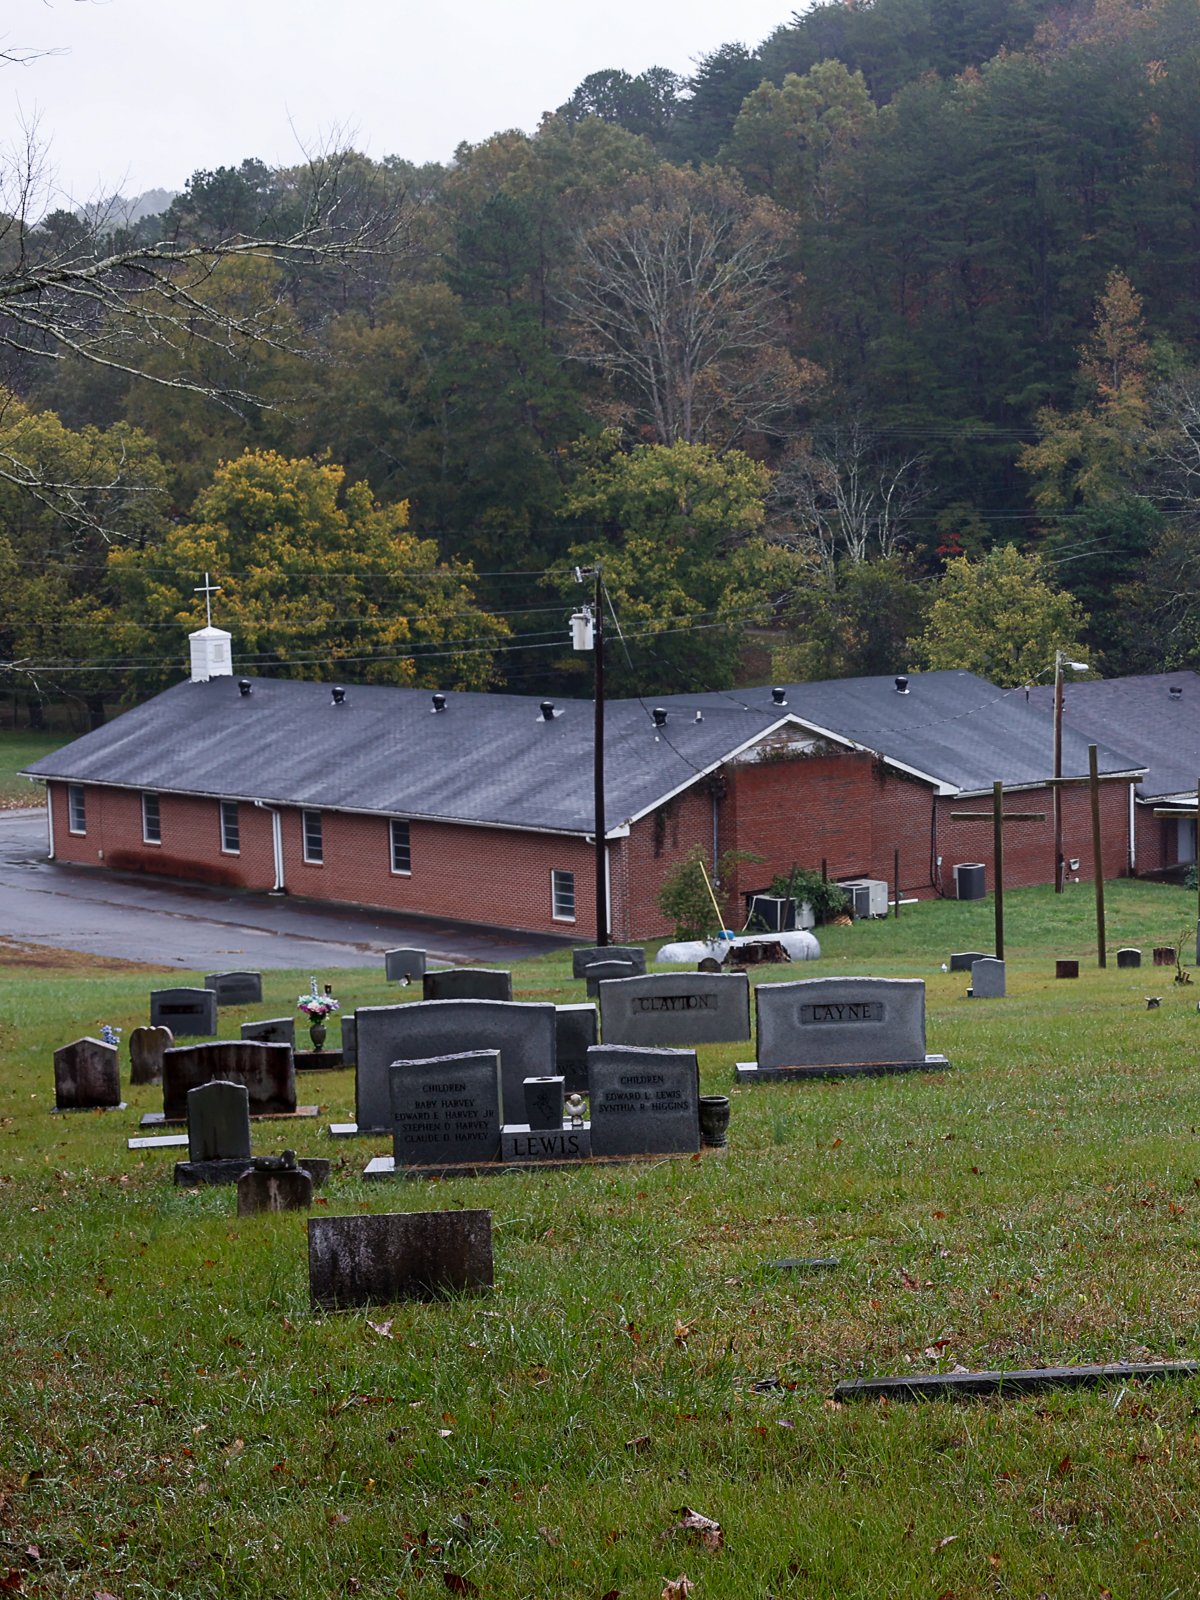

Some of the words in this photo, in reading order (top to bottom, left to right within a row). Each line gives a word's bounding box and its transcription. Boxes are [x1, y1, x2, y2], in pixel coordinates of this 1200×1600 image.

[640, 996, 709, 1011] CLAYTON
[813, 1004, 871, 1020] LAYNE
[620, 1075, 664, 1085] CHILDREN
[422, 1083, 466, 1093] CHILDREN
[605, 1092, 641, 1101] EDWARD
[656, 1090, 681, 1100] LEWIS
[415, 1101, 437, 1109] BABY
[441, 1099, 475, 1108] HARVEY
[651, 1101, 689, 1111] HIGGINS
[394, 1112, 430, 1121] EDWARD
[445, 1110, 479, 1119] HARVEY
[402, 1123, 441, 1132] STEPHEN
[455, 1121, 489, 1130] HARVEY
[404, 1134, 441, 1143] CLAUDE
[455, 1132, 489, 1141] HARVEY
[513, 1135, 579, 1155] LEWIS
